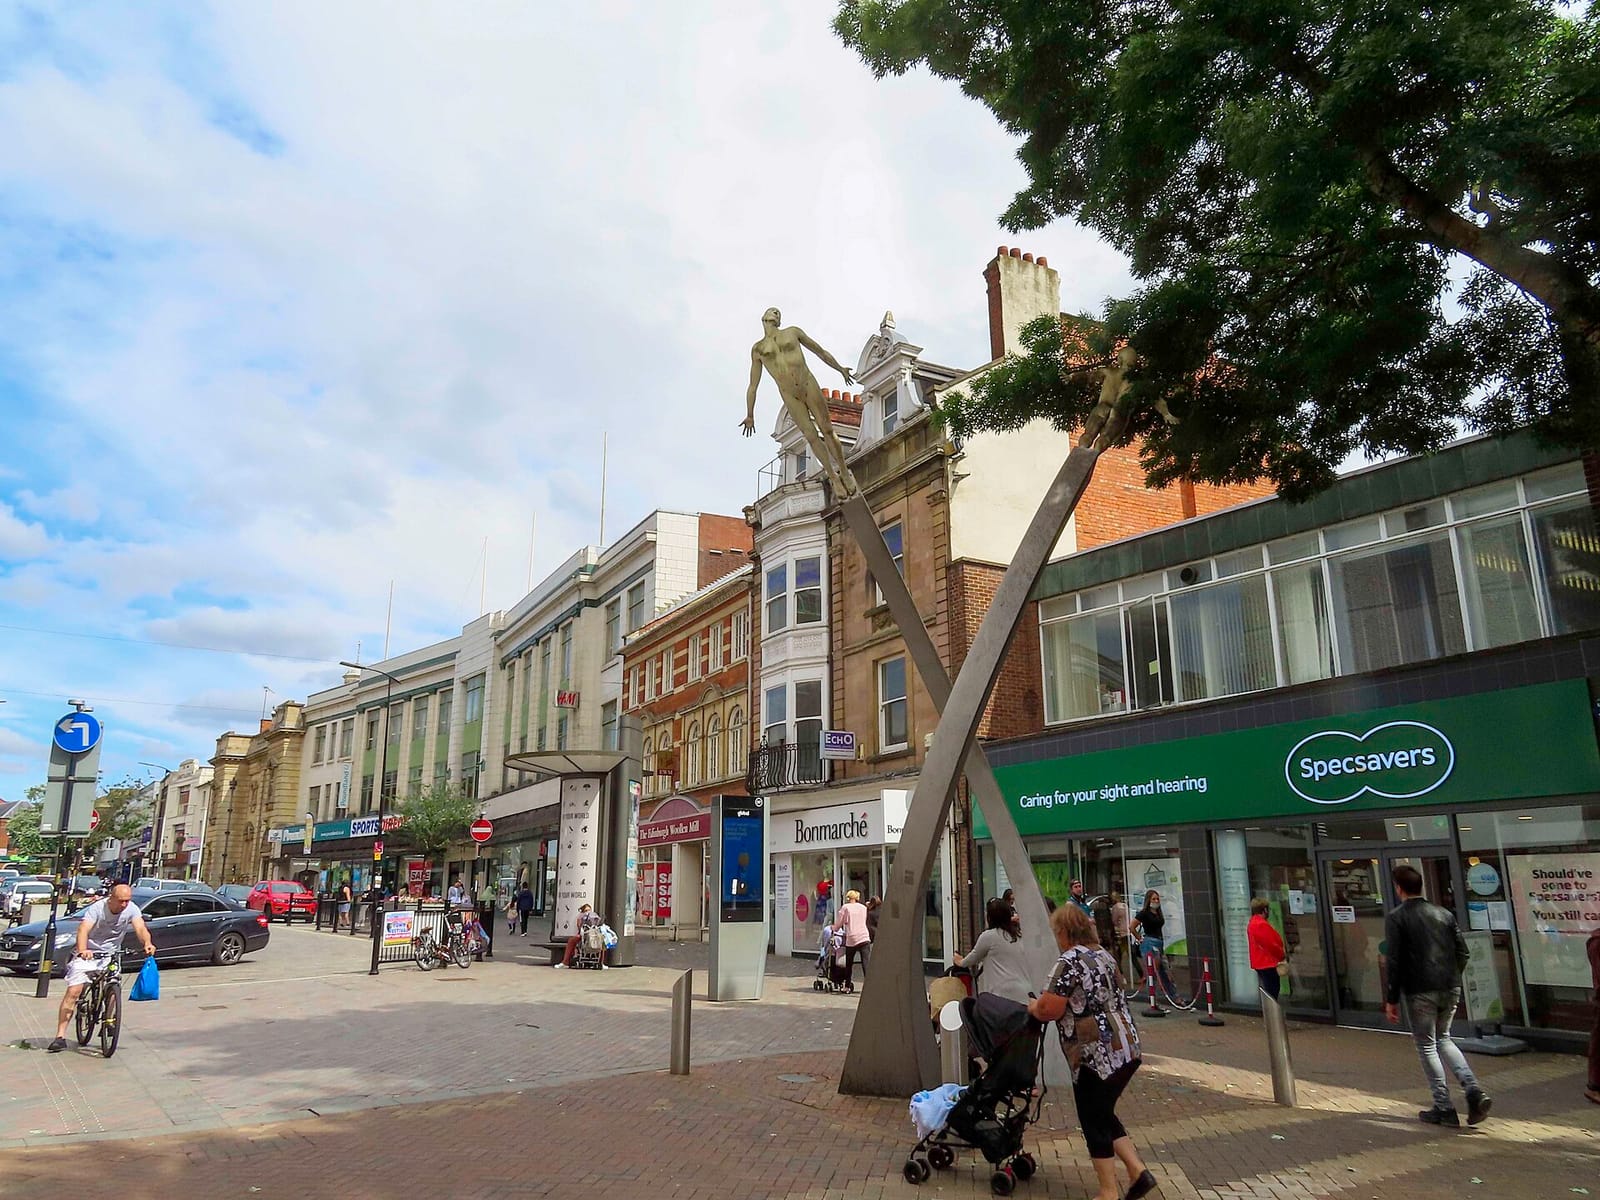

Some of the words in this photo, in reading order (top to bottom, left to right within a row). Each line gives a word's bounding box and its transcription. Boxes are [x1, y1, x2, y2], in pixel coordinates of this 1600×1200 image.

[557, 691, 576, 706] H&M
[1300, 747, 1436, 782] Specsavers
[1019, 792, 1053, 809] Caring
[1053, 790, 1071, 805] for
[1072, 788, 1098, 806] your
[1099, 783, 1129, 802] sight
[1130, 780, 1154, 797] and
[1155, 775, 1208, 794] hearing
[351, 819, 379, 835] SPORTS
[639, 830, 648, 840] The
[647, 825, 669, 840] Edinburgh
[669, 822, 689, 835] Woollen
[688, 819, 700, 833] Mill
[794, 811, 869, 844] Bonmarché
[887, 824, 903, 834] Bon
[1531, 869, 1593, 879] Should've
[1541, 882, 1572, 893] gone
[1573, 881, 1588, 890] to
[1532, 910, 1556, 921] You
[1557, 910, 1581, 921] still
